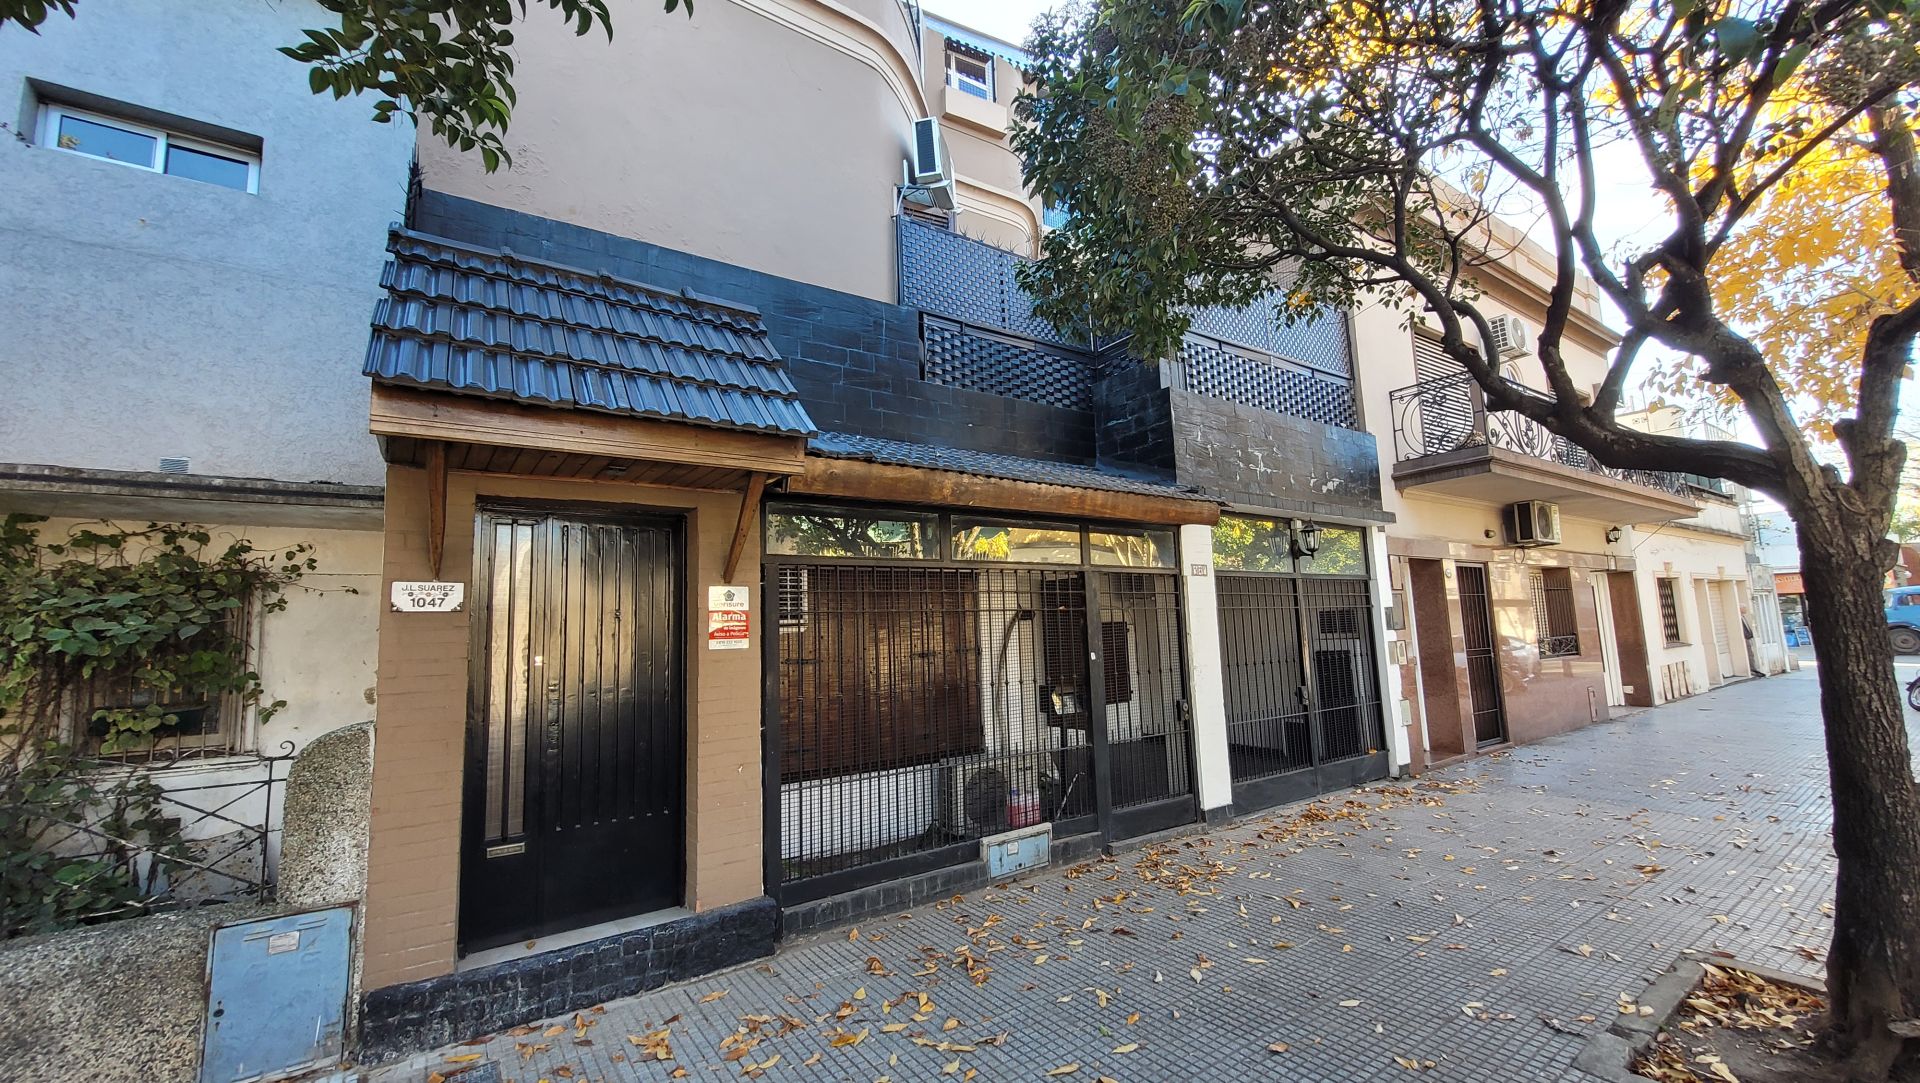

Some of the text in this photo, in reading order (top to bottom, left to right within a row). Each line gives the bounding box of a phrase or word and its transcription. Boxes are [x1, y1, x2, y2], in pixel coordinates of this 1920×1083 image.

[417, 584, 456, 592] SUAREZ
[409, 597, 446, 608] 1047
[712, 612, 746, 621] Alarma
